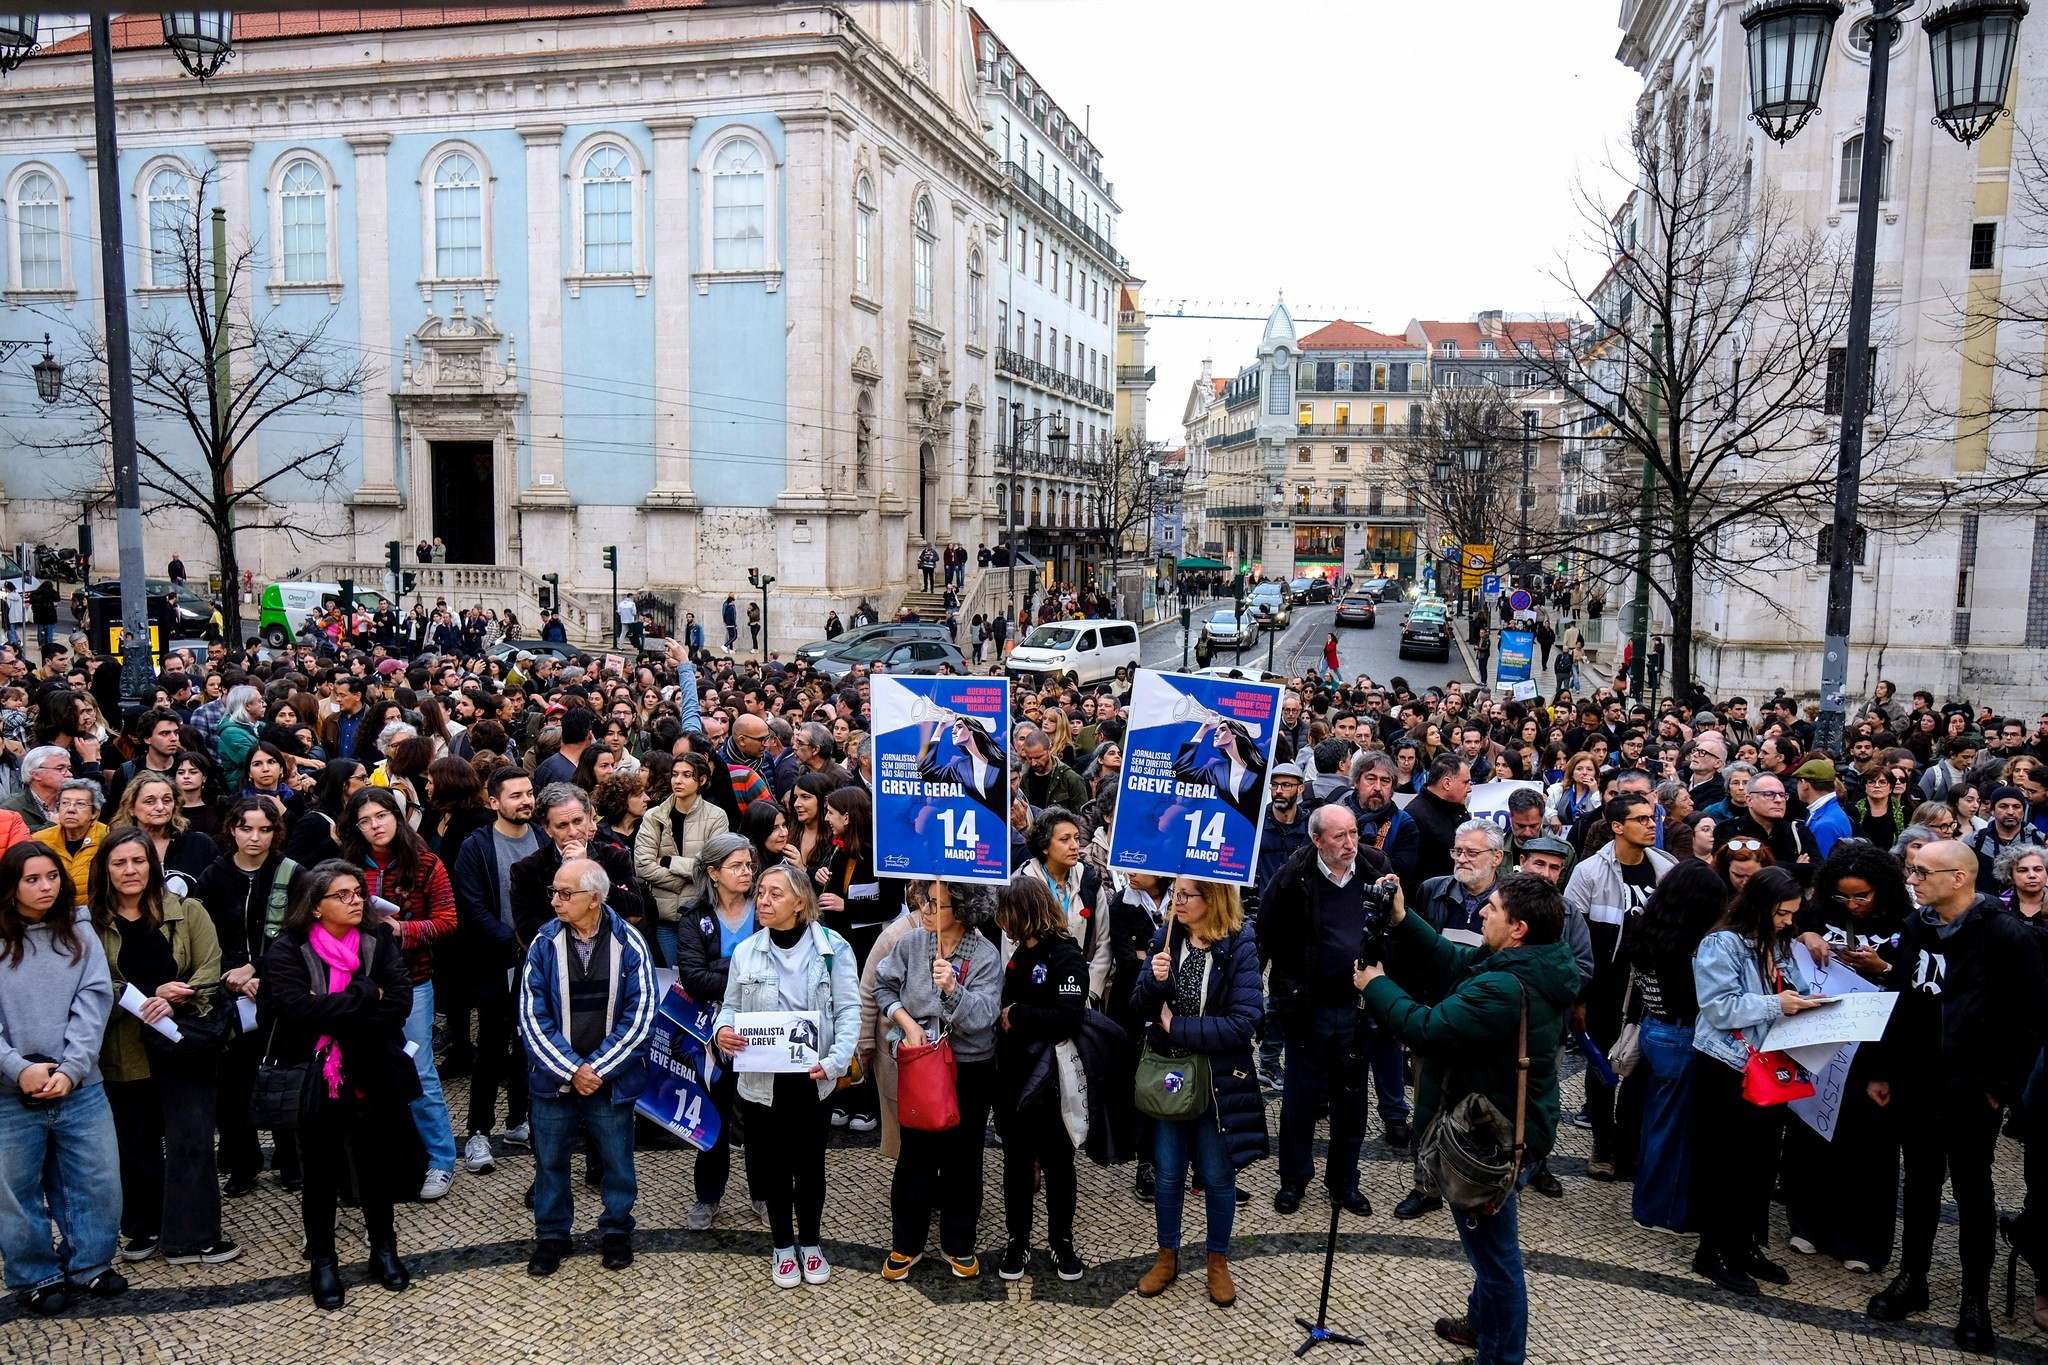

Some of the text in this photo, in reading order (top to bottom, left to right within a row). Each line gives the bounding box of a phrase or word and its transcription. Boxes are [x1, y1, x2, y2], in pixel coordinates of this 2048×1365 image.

[1486, 577, 1496, 590] P
[288, 594, 307, 602] Orona
[967, 687, 1001, 696] QUEREMOS
[1235, 691, 1273, 702] QUEREMOS
[951, 695, 1002, 704] LIBERDADE COM
[1217, 697, 1271, 710] LIBERDADE COM
[966, 704, 1002, 713] DIGNIDADE
[1233, 707, 1270, 719] DIGNIDADE
[881, 753, 916, 762] JORNALISTAS
[1131, 749, 1172, 761] JORNALISTAS
[881, 762, 918, 771] SEM DIREITOS
[1130, 757, 1173, 769] SEM DIREITOS
[881, 769, 923, 780] NÃO SÃO LIVRES
[1129, 765, 1177, 778] NÃO SÃO LIVRES
[881, 779, 966, 798] GREVE GERAL
[1127, 775, 1218, 800] GREVE GERAL
[936, 808, 980, 849] 14
[1184, 809, 1226, 850] 14
[944, 848, 976, 862] MARÇO
[1185, 848, 1219, 863] MARÇO
[1058, 984, 1082, 992] LUSA
[1841, 995, 1883, 1007] MOR
[695, 1011, 708, 1027] 14
[655, 1027, 670, 1040] ALISTAS
[738, 1027, 785, 1037] JORNALISTA
[751, 1037, 777, 1046] GREVE
[788, 1045, 804, 1060] 14
[650, 1047, 697, 1085] REVE GERAL
[1817, 1050, 1849, 1132] ALISMO
[674, 1088, 702, 1130] 14
